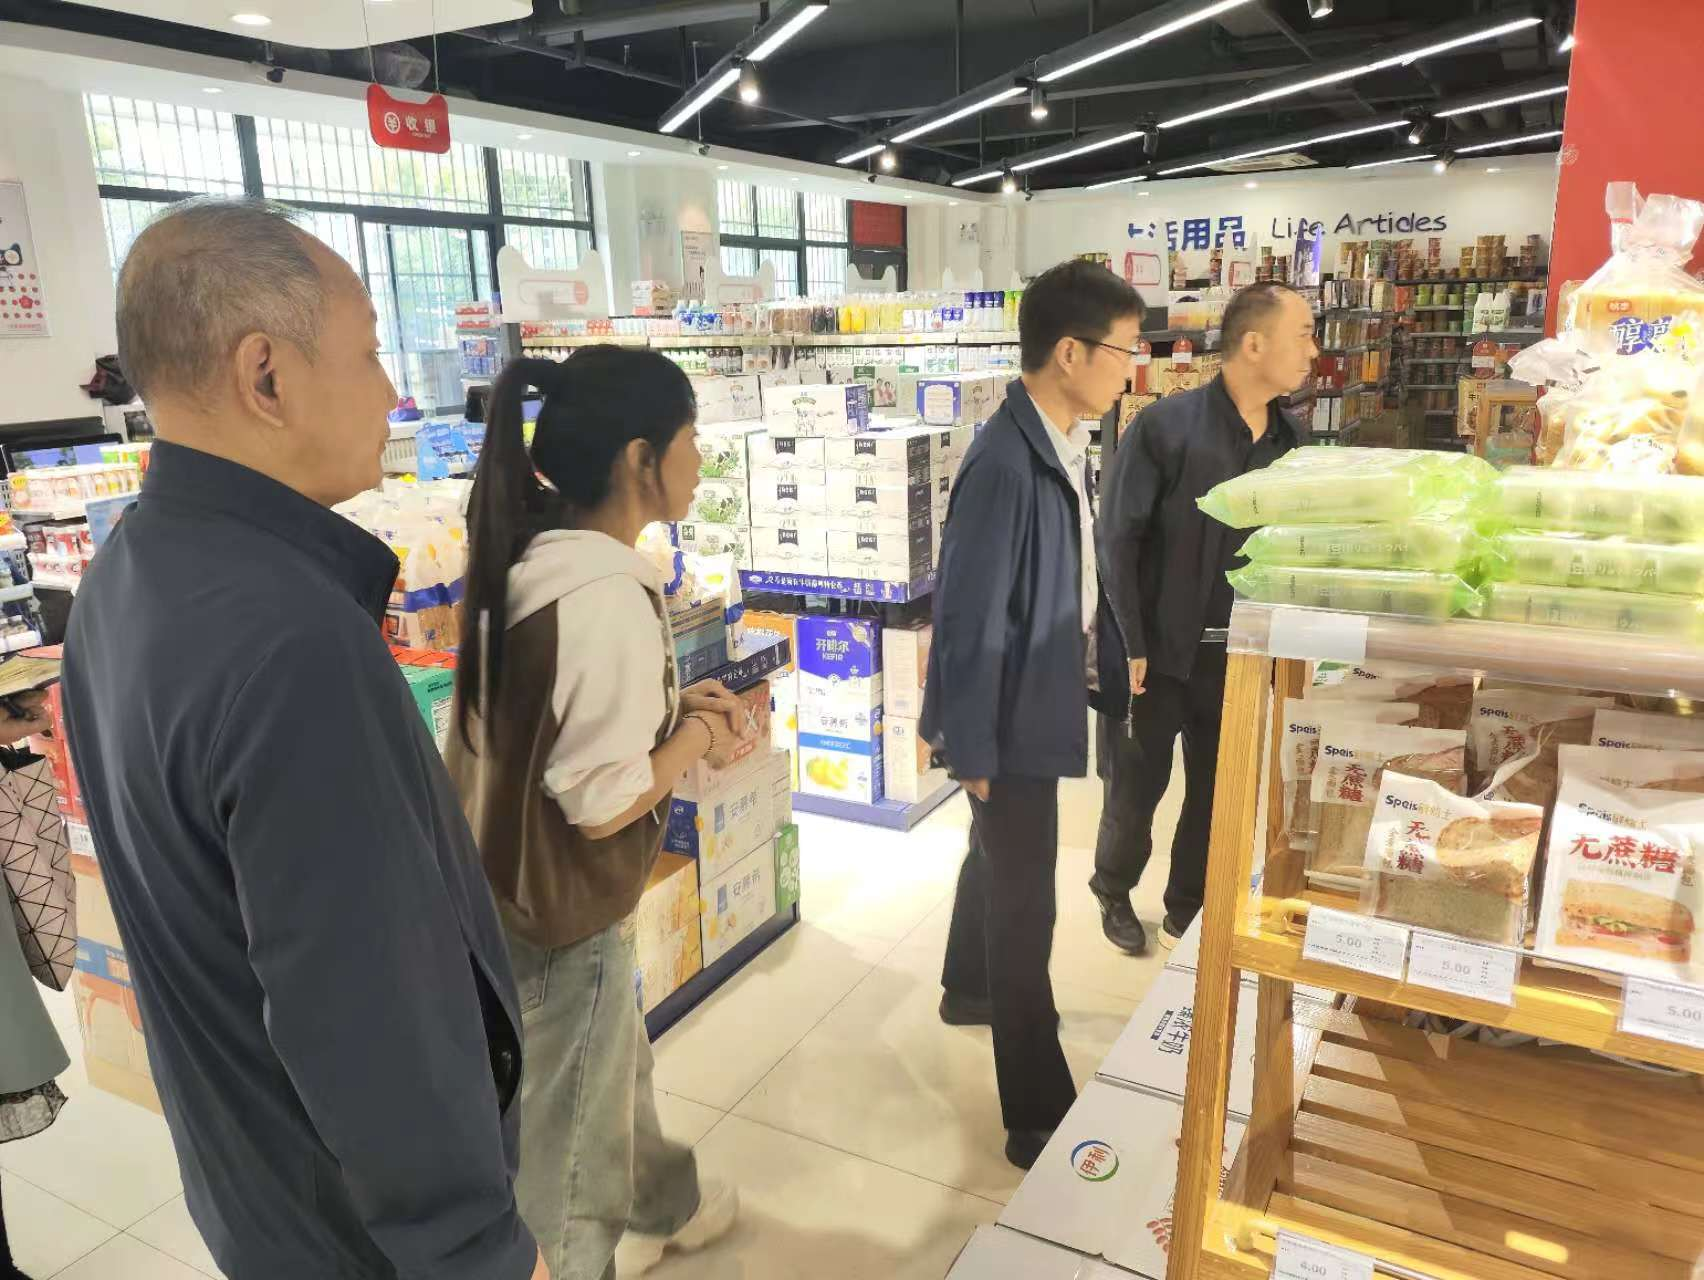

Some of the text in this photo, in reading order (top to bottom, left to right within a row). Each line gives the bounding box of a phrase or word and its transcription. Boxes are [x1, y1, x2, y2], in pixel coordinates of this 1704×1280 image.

[1333, 211, 1448, 237] Articles
[1479, 706, 1509, 719] Speis
[1289, 723, 1318, 735] Speis
[1324, 744, 1355, 758] Speis
[1384, 794, 1418, 812] Speis
[1569, 834, 1682, 875] 无蔗糖
[1079, 1145, 1111, 1177] 伊利
